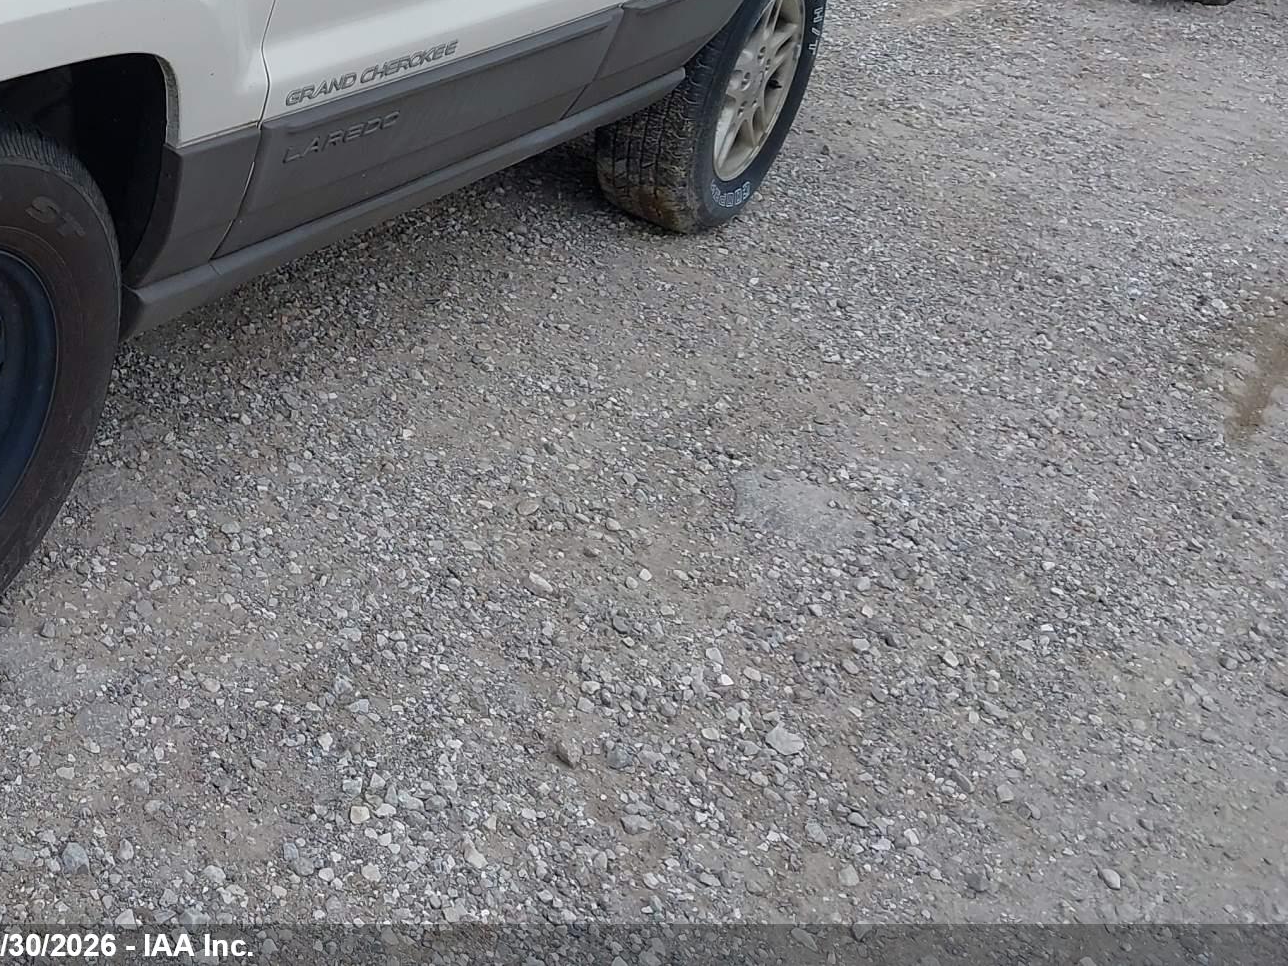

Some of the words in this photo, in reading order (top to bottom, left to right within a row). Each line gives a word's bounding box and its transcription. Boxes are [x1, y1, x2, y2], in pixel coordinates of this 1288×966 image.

[285, 72, 357, 107] GRAND
[360, 39, 459, 85] CHEROKEE
[281, 111, 401, 164] LAREDO
